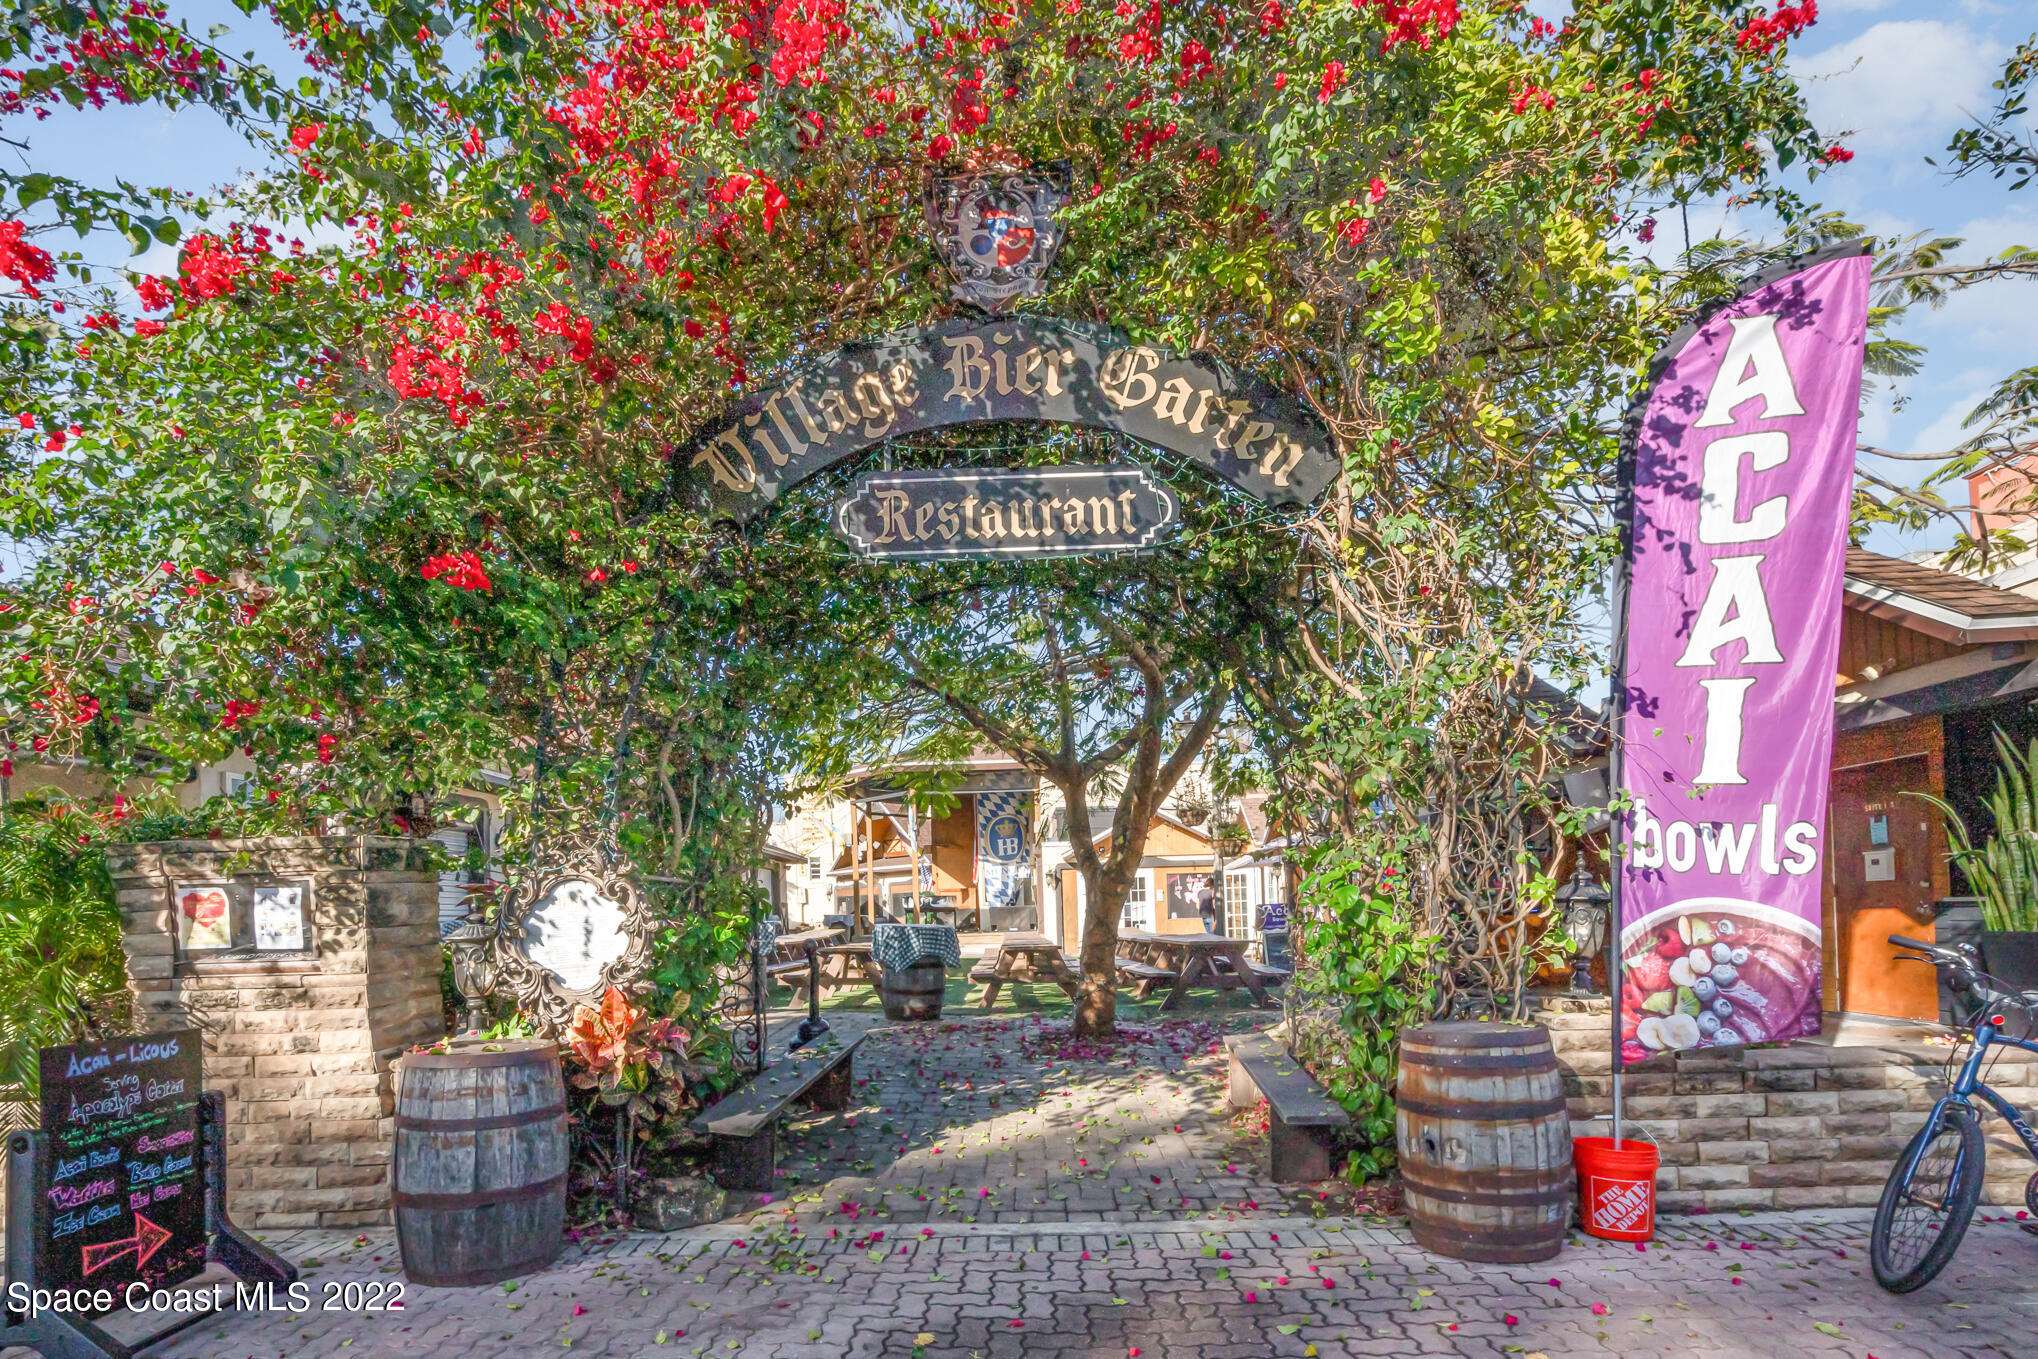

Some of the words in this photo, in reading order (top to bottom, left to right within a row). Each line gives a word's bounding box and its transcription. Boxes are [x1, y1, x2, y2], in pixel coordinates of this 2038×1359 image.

[692, 357, 920, 493] Village
[942, 331, 1076, 404] Bier
[1099, 346, 1305, 487] Garten
[873, 488, 1137, 545] Restaurant
[1674, 313, 1808, 786] ACAI
[997, 837, 1019, 857] HB
[1632, 797, 1819, 877] bowls
[65, 1048, 111, 1078] Acai
[129, 1038, 180, 1063] Licous
[1594, 1181, 1648, 1228] HOME
[1597, 1185, 1625, 1204] THE
[1616, 1200, 1649, 1231] DEPOT
